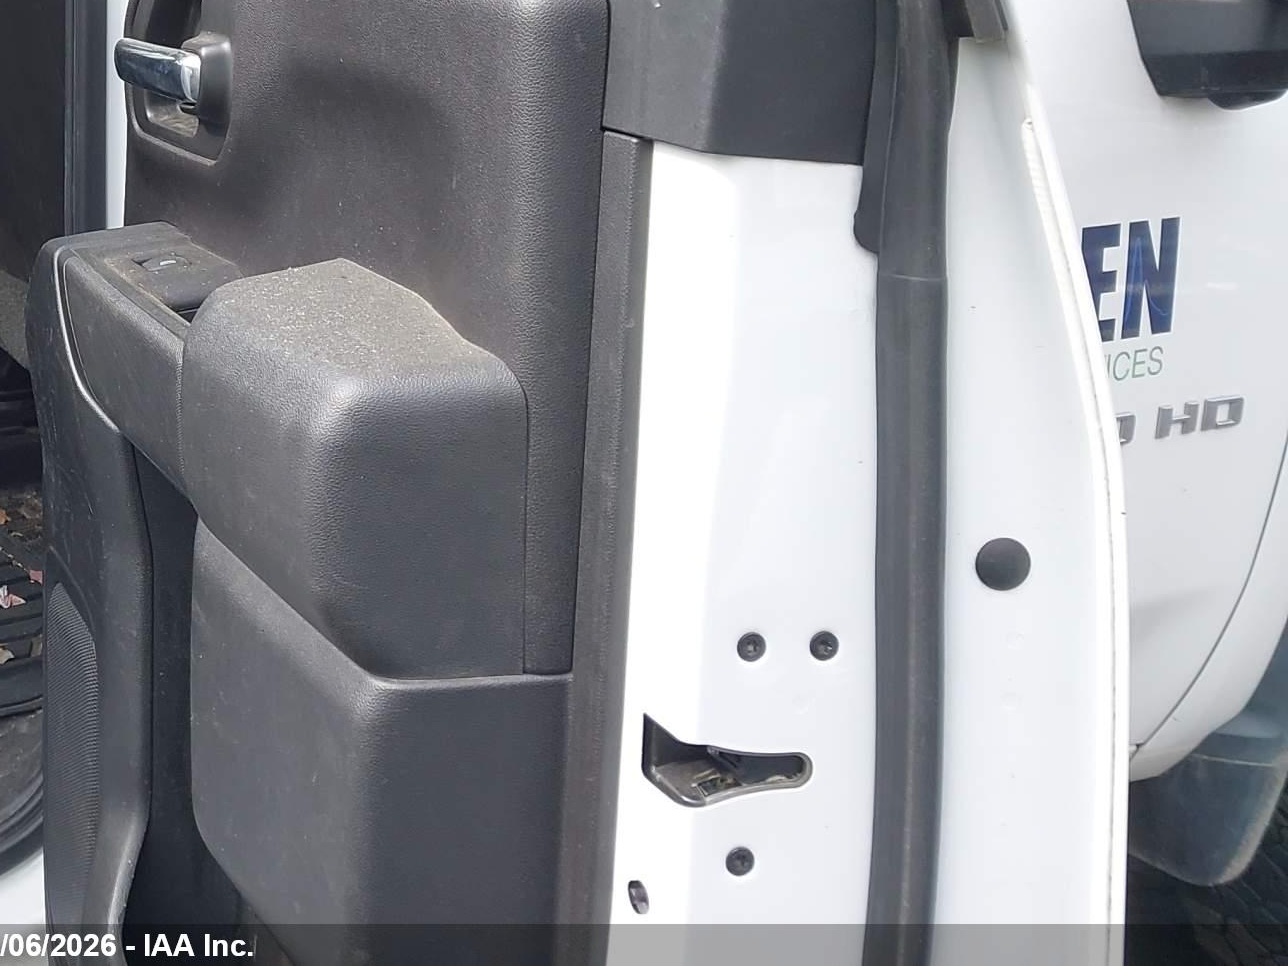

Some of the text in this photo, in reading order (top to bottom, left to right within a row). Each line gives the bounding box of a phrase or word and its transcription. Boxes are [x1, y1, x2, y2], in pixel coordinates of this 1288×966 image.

[1081, 217, 1180, 342] EN
[1104, 346, 1164, 381] ICES
[1155, 395, 1244, 439] HD
